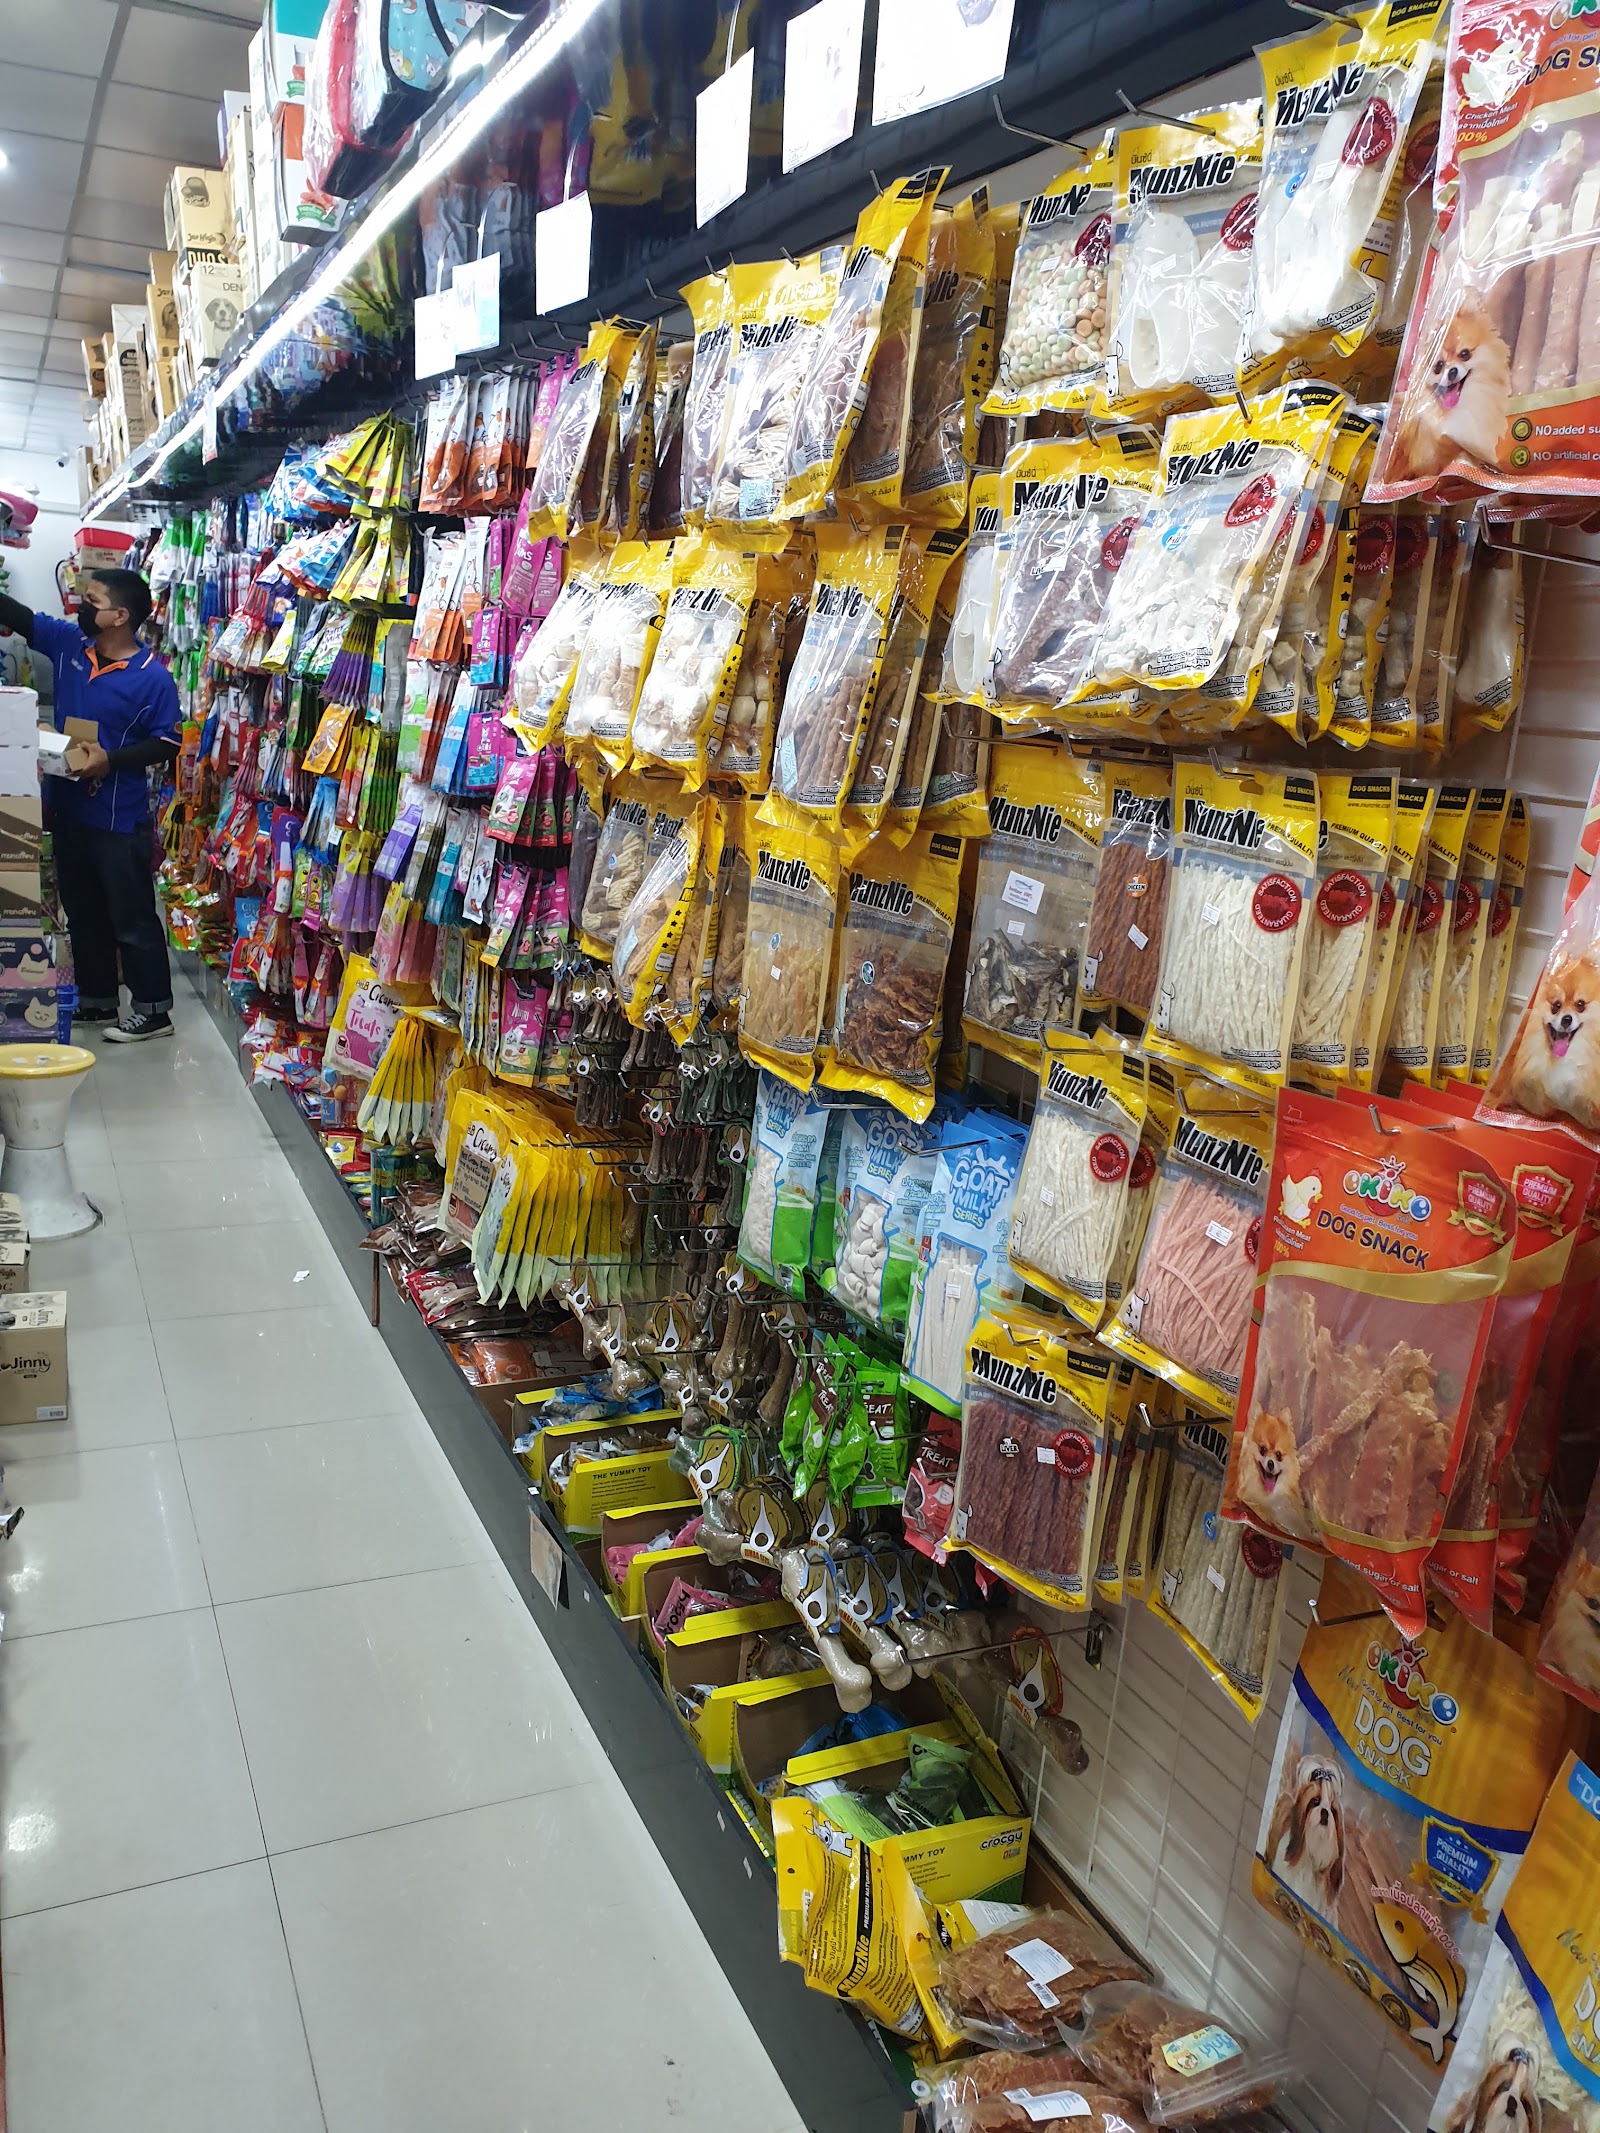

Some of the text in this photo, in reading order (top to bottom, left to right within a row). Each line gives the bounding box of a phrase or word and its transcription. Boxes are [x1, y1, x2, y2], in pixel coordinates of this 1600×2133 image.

[1535, 424, 1552, 436] NO
[1552, 425, 1586, 436] added
[1533, 451, 1551, 462] NO
[1553, 450, 1590, 461] artificial
[1352, 785, 1391, 794] DOG SNACKS
[990, 795, 1062, 844] MunzNie
[1183, 798, 1265, 849] MunzNie
[1331, 822, 1360, 837] PREMIUM
[1257, 877, 1297, 903] SATISFACTION
[1324, 873, 1367, 898] SATISFACTION
[1254, 902, 1294, 929] GUARANTEED
[1319, 899, 1363, 922] GUARANTEED
[767, 1107, 795, 1130] MILK
[870, 1146, 909, 1172] MILK
[1095, 1137, 1126, 1160] SATISFACTION
[1173, 1116, 1264, 1184] MunzNie
[868, 1163, 893, 1183] SERIES
[951, 1158, 1010, 1204] GOAT
[1091, 1156, 1122, 1182] GUARANTEED
[1343, 1169, 1432, 1222] OKIKO
[1467, 1184, 1497, 1204] PREMIUM
[1523, 1178, 1558, 1197] PREMIUM
[952, 1187, 993, 1217] MILK
[954, 1208, 985, 1228] SERIES
[1317, 1210, 1356, 1241] DOG
[1359, 1228, 1430, 1270] SNACK
[11, 1356, 51, 1373] Jinny
[971, 1347, 1057, 1404] MunzNie
[1080, 1361, 1107, 1373] SNACKS
[1000, 1444, 1019, 1453] LIVER
[1056, 1430, 1090, 1456] SATISFACTION
[921, 1446, 954, 1469] TREAT
[609, 1468, 637, 1479] YUMMY
[637, 1466, 652, 1474] TOY
[1391, 1579, 1401, 1587] or
[1402, 1583, 1420, 1593] salt
[1450, 1570, 1460, 1578] or
[1461, 1573, 1480, 1586] salt
[1366, 1640, 1460, 1726] OKIKO
[1354, 1695, 1432, 1777] DOG
[1382, 1702, 1395, 1714] pet
[1396, 1711, 1415, 1729] Best
[1415, 1722, 1427, 1736] for
[1427, 1732, 1443, 1746] you
[1356, 1739, 1413, 1790] SNACK
[927, 1846, 946, 1858] TOY
[980, 1831, 1023, 1850] crocgy
[1436, 1837, 1479, 1868] PREMIUM
[1436, 1850, 1475, 1879] QUALITY
[838, 1934, 871, 1998] MunzNie
